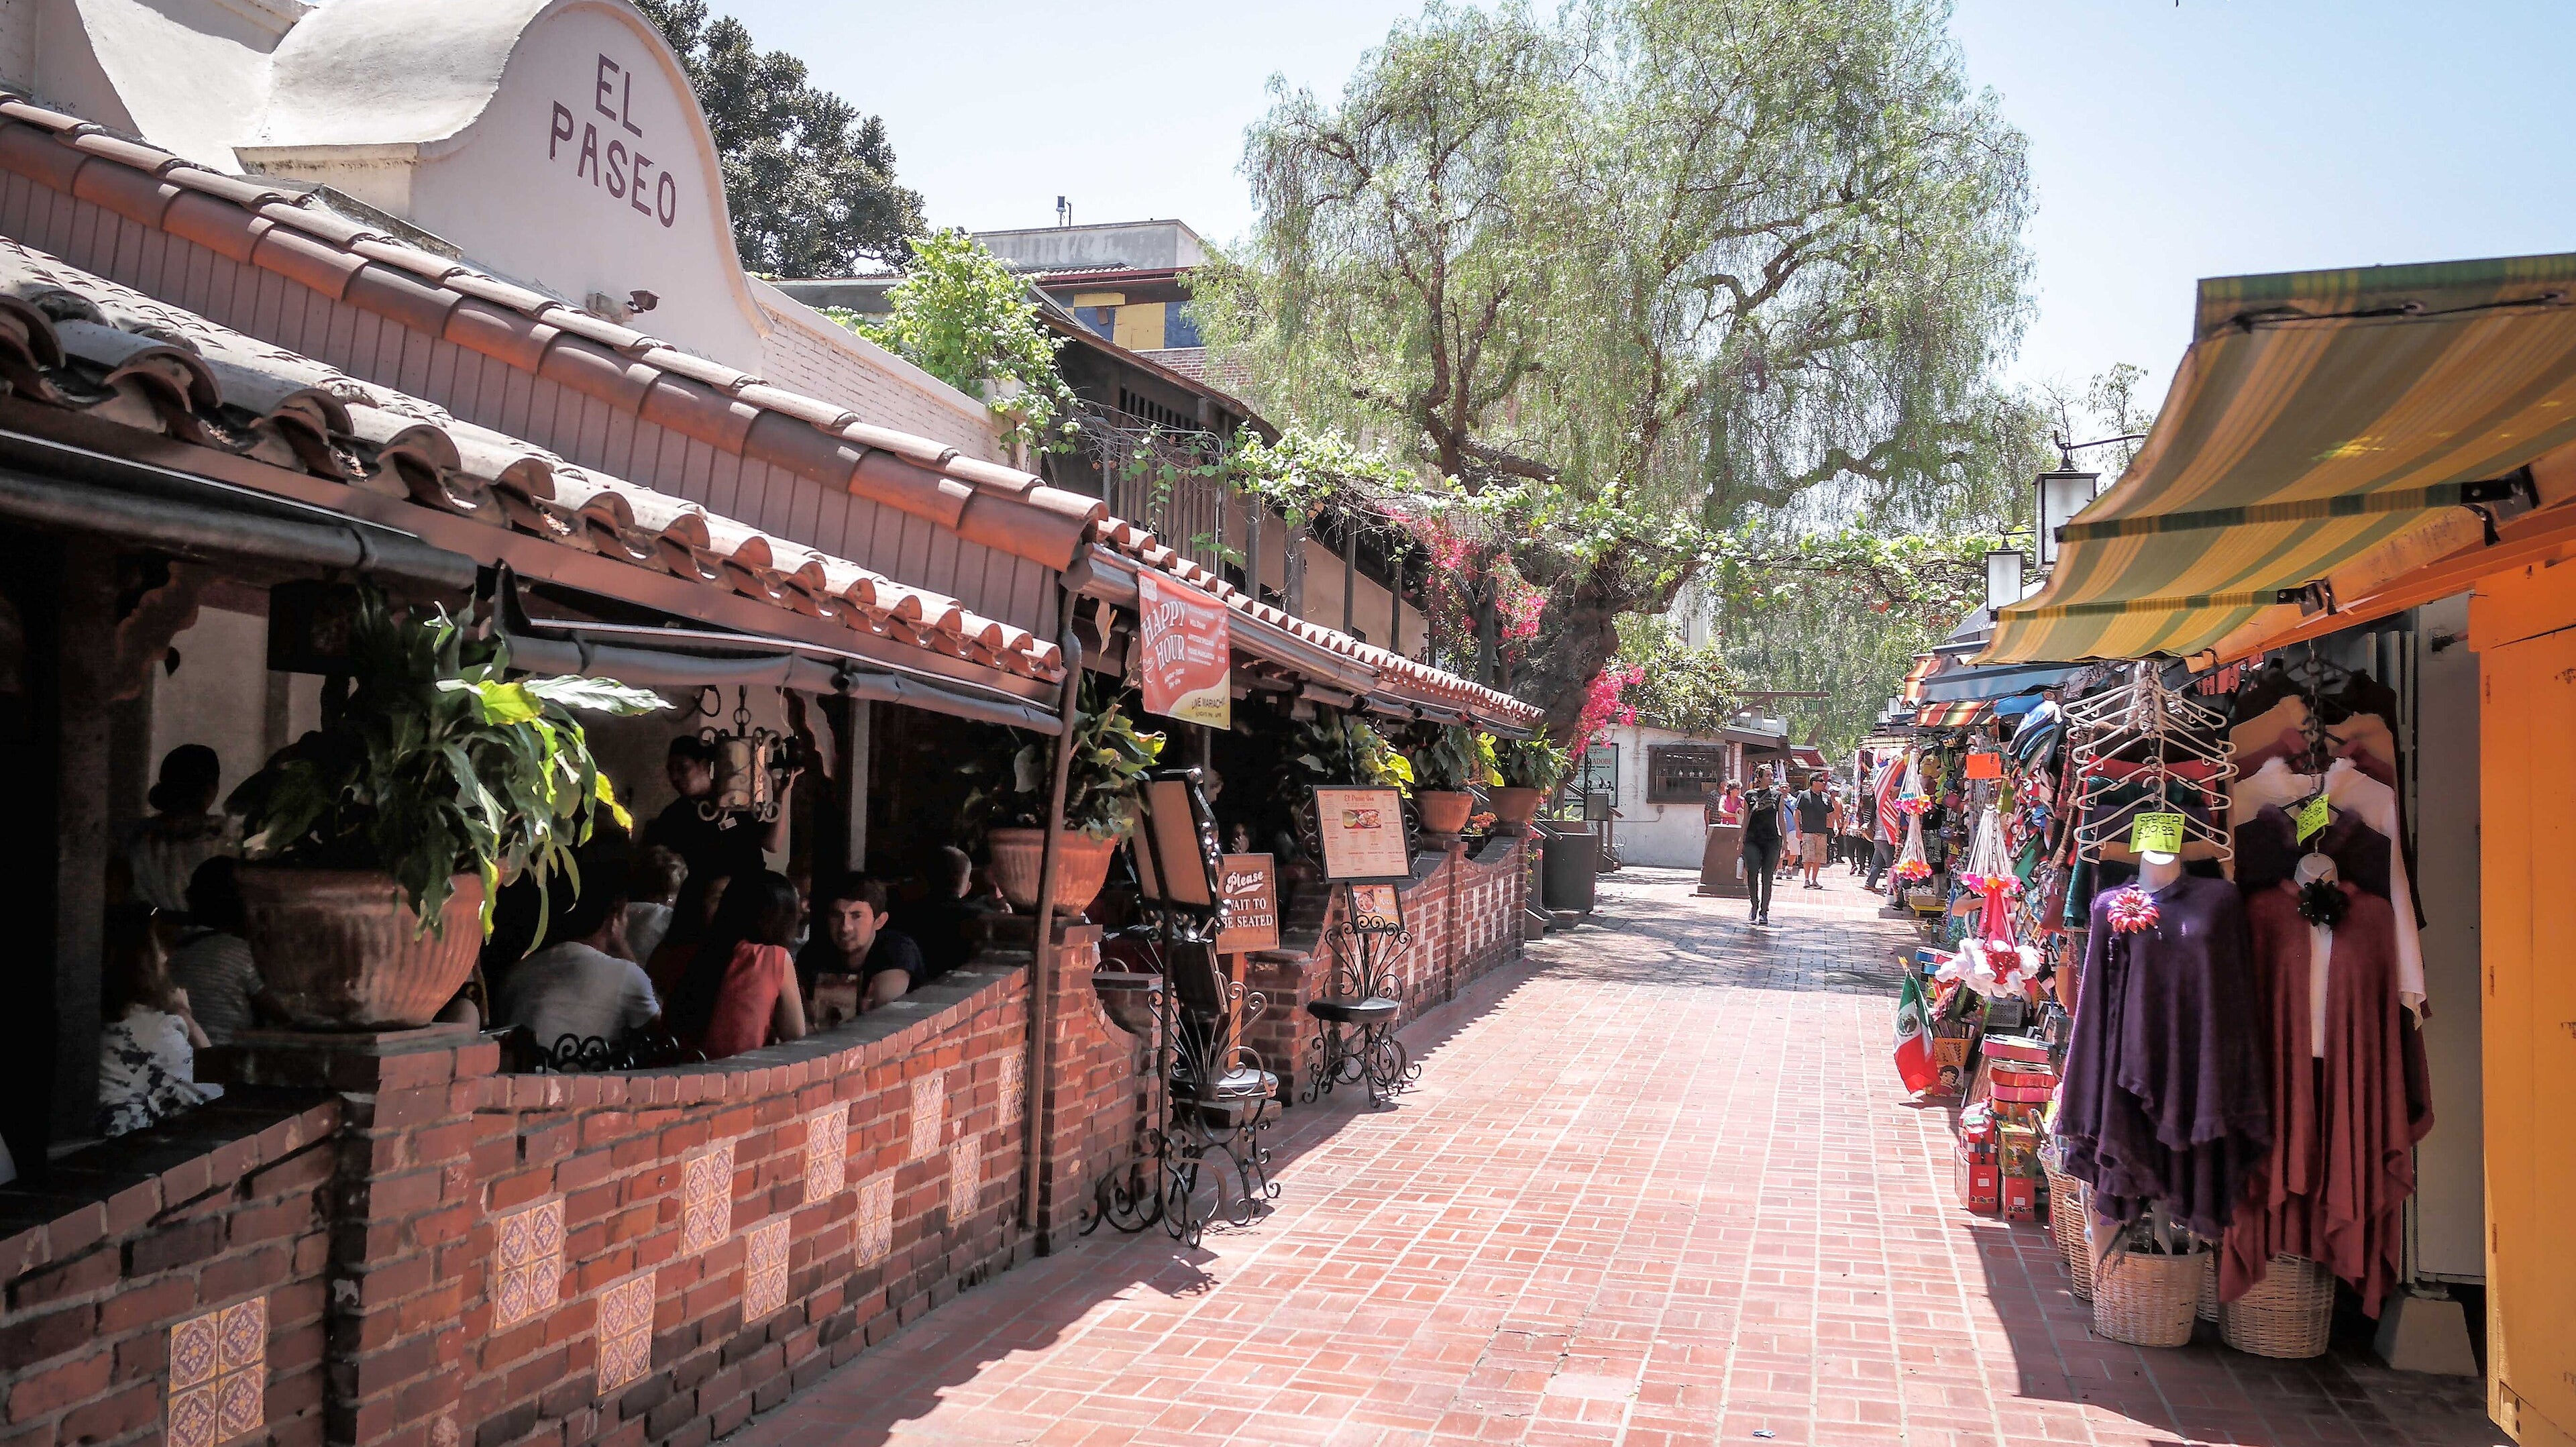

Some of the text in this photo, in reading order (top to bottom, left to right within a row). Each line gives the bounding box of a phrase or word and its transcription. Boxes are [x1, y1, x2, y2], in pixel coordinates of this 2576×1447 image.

[596, 52, 643, 139] EL
[549, 100, 676, 228] PASEO
[1140, 600, 1186, 649] HAPPY
[1155, 634, 1185, 672] HOUR
[1807, 702, 1819, 711] EXIT
[2140, 814, 2184, 826] SPECIAL
[1225, 871, 1265, 894] Please
[1252, 898, 1267, 910] TO
[1237, 914, 1273, 928] SEATED
